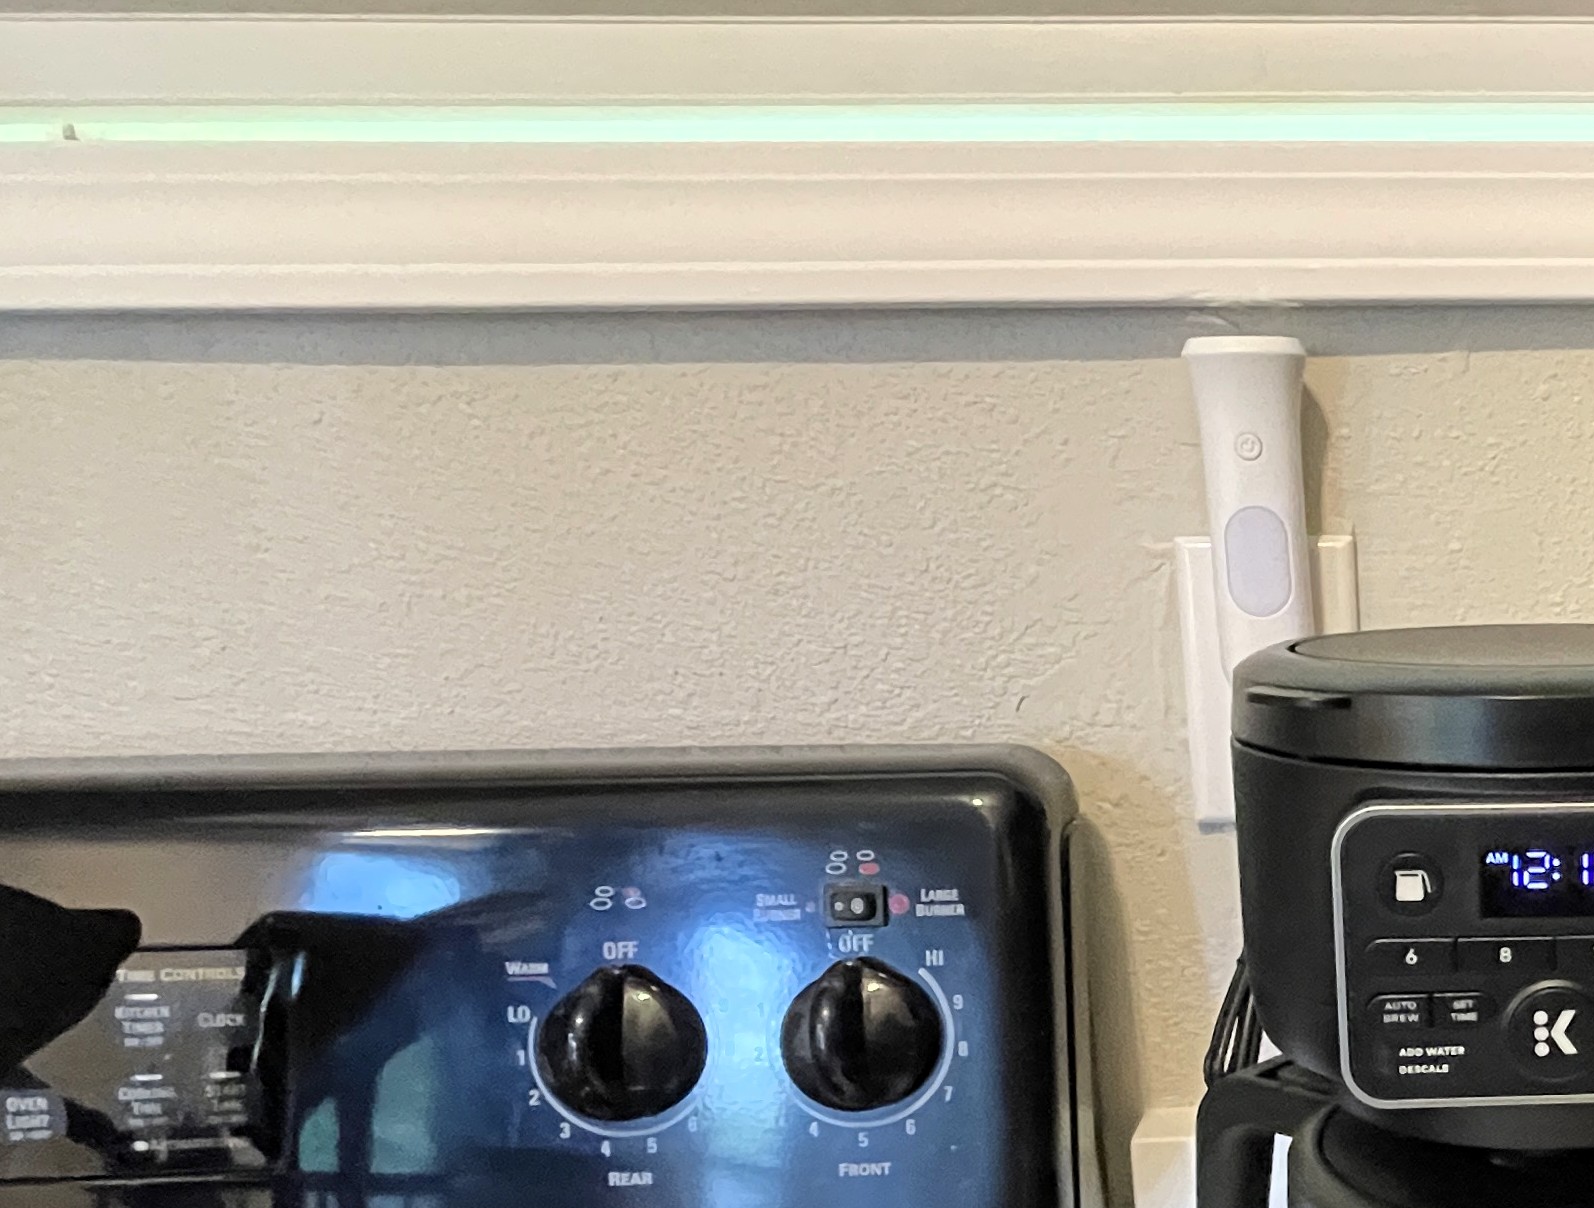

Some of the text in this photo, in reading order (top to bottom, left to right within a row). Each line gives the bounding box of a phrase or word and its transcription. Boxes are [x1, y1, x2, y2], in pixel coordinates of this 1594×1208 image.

[1486, 852, 1509, 864] AM
[603, 941, 639, 959] OFF
[838, 933, 874, 953] OFF
[925, 950, 944, 966] HI
[1405, 949, 1418, 965] 6
[1499, 947, 1512, 963] 8
[953, 994, 964, 1010] 9
[1384, 1001, 1417, 1010] AUTO
[507, 1006, 531, 1023] LO
[516, 1050, 526, 1066] 1
[1399, 1045, 1465, 1056] ADD WATER
[529, 1089, 541, 1106] 2
[943, 1085, 954, 1102] 7
[560, 1122, 571, 1139] 3
[809, 1121, 819, 1137] 4
[905, 1118, 916, 1135] 6
[647, 1137, 658, 1153] 5
[858, 1132, 869, 1147] 5
[601, 1140, 611, 1157] 4
[838, 1162, 892, 1177] FRONT
[608, 1171, 654, 1186] REAR
